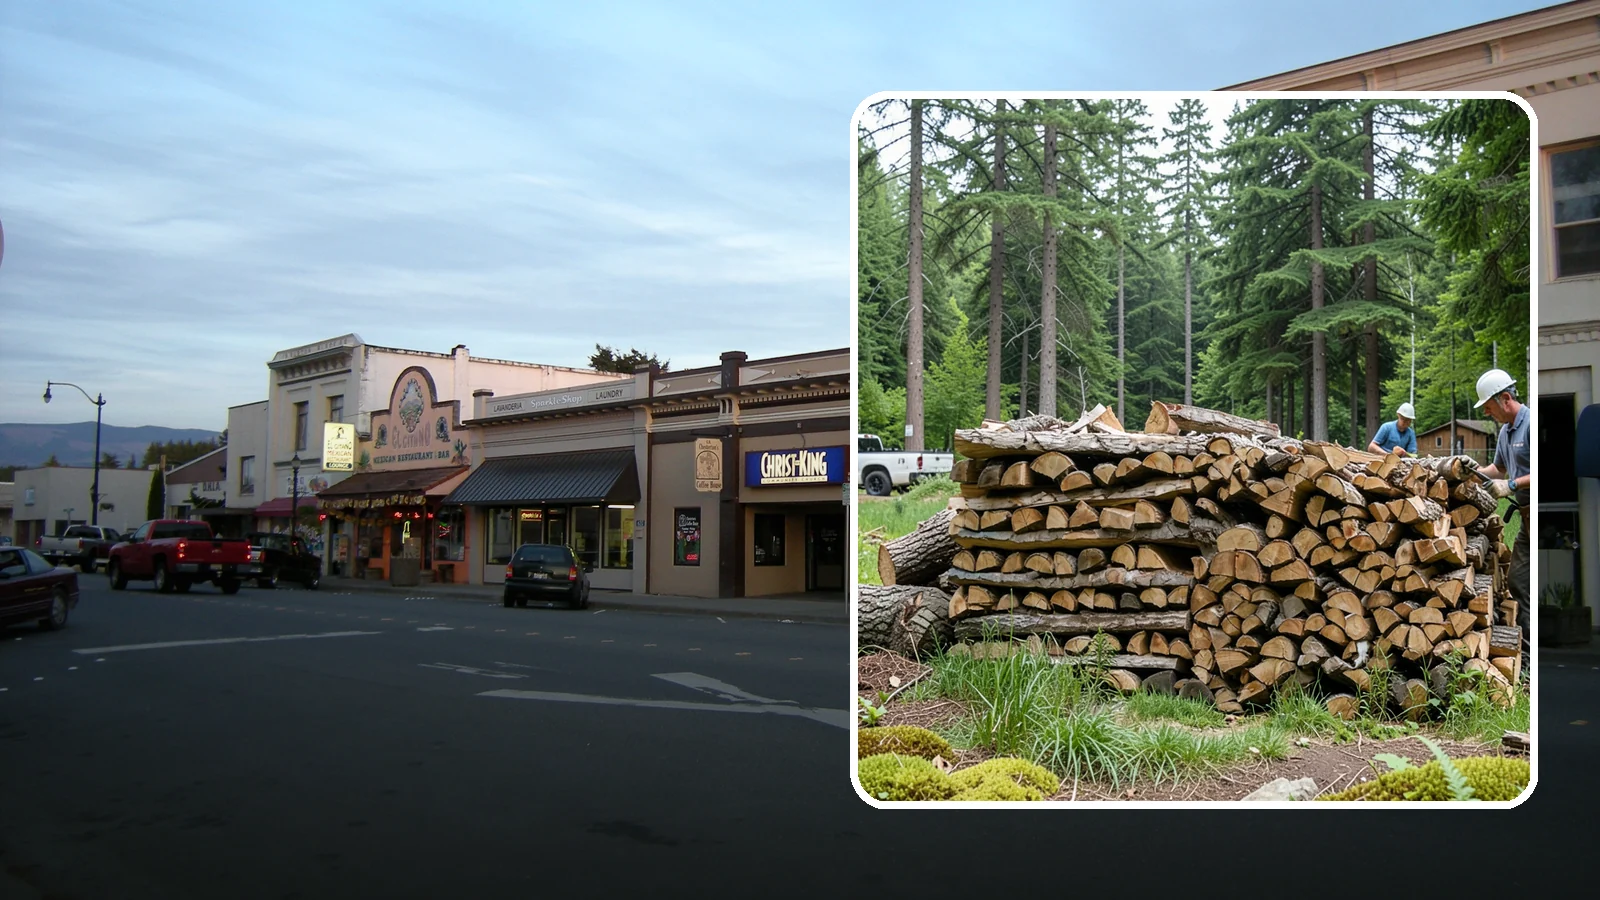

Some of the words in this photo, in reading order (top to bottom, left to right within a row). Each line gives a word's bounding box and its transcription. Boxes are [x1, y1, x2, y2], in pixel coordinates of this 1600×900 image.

[595, 389, 624, 400] LAUNDRY
[494, 402, 522, 412] LAVANDERIA
[530, 396, 561, 409] Sparkle
[561, 394, 582, 404] Shop
[398, 451, 433, 462] RESTAURANT
[438, 450, 449, 458] BAR
[761, 452, 797, 477] CHRIST
[799, 450, 827, 476] KING
